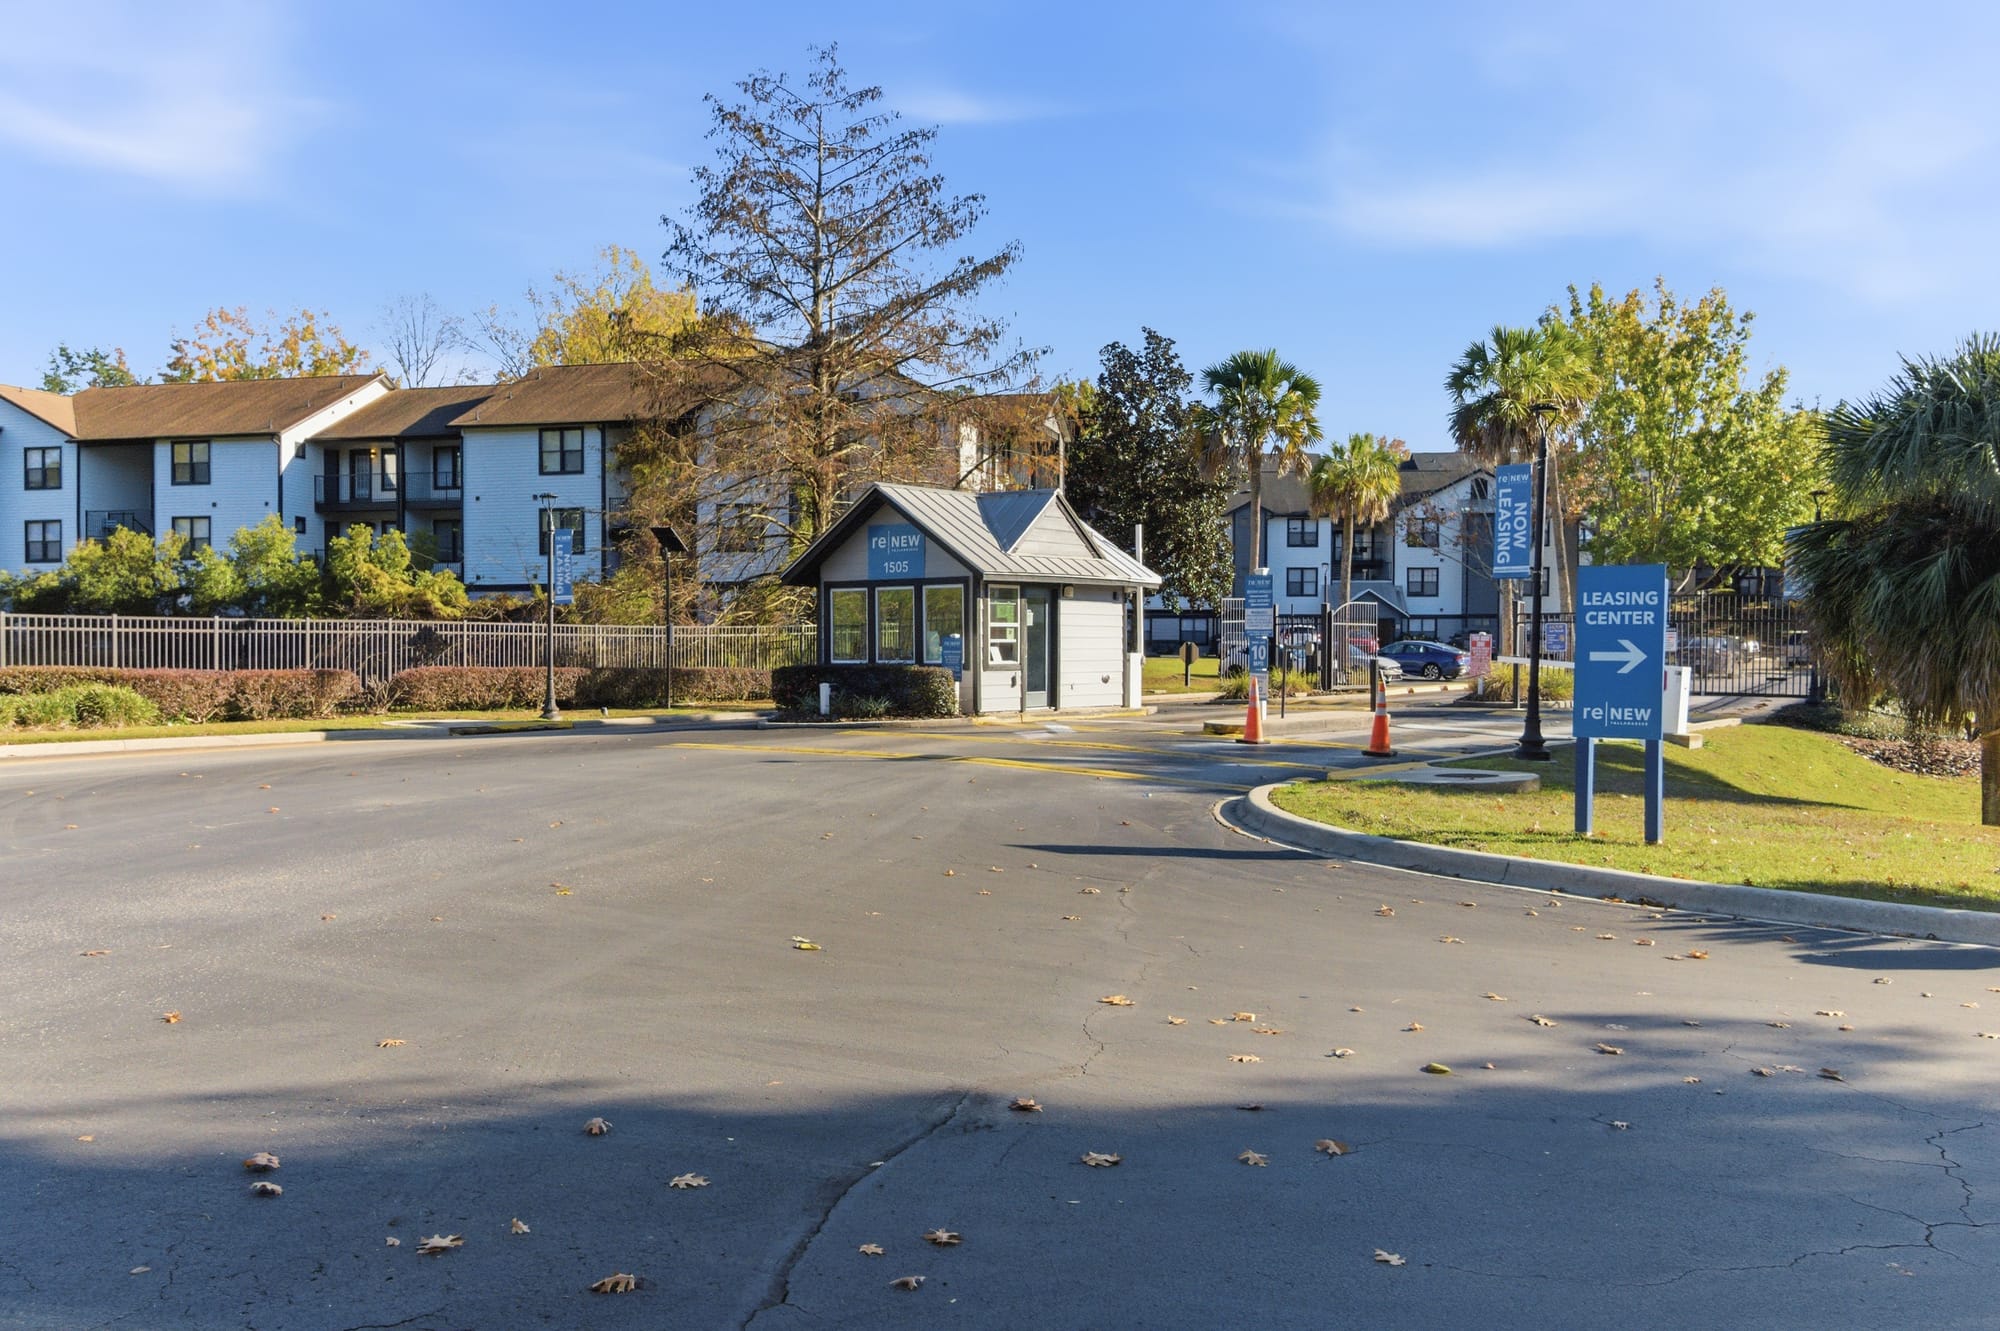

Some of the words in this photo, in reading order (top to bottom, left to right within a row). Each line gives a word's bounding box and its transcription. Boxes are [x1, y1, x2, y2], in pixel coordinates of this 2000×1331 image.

[1497, 488, 1512, 564] LEASING
[1513, 502, 1528, 549] NOW
[556, 544, 564, 595] LEASING
[883, 561, 909, 574] 1505
[1582, 591, 1659, 606] LEASING
[1585, 611, 1655, 625] CENTER
[1251, 645, 1266, 660] 10
